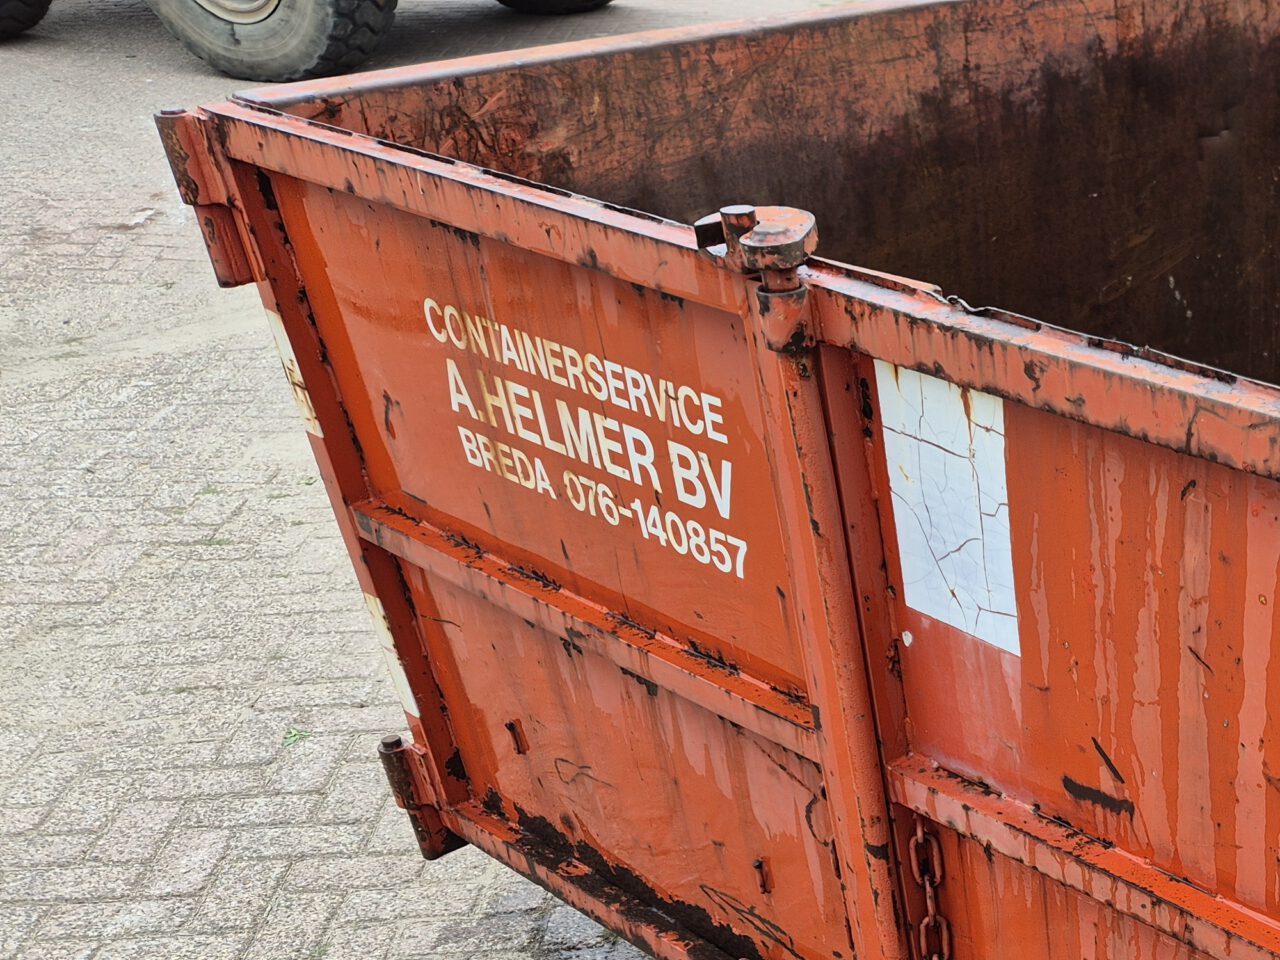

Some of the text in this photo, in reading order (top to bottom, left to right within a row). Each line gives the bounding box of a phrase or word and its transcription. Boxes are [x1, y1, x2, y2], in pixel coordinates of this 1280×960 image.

[424, 298, 728, 444] CONTAINERSERVICE
[457, 426, 748, 579] BREDA 076-140857
[667, 440, 732, 520] BV
